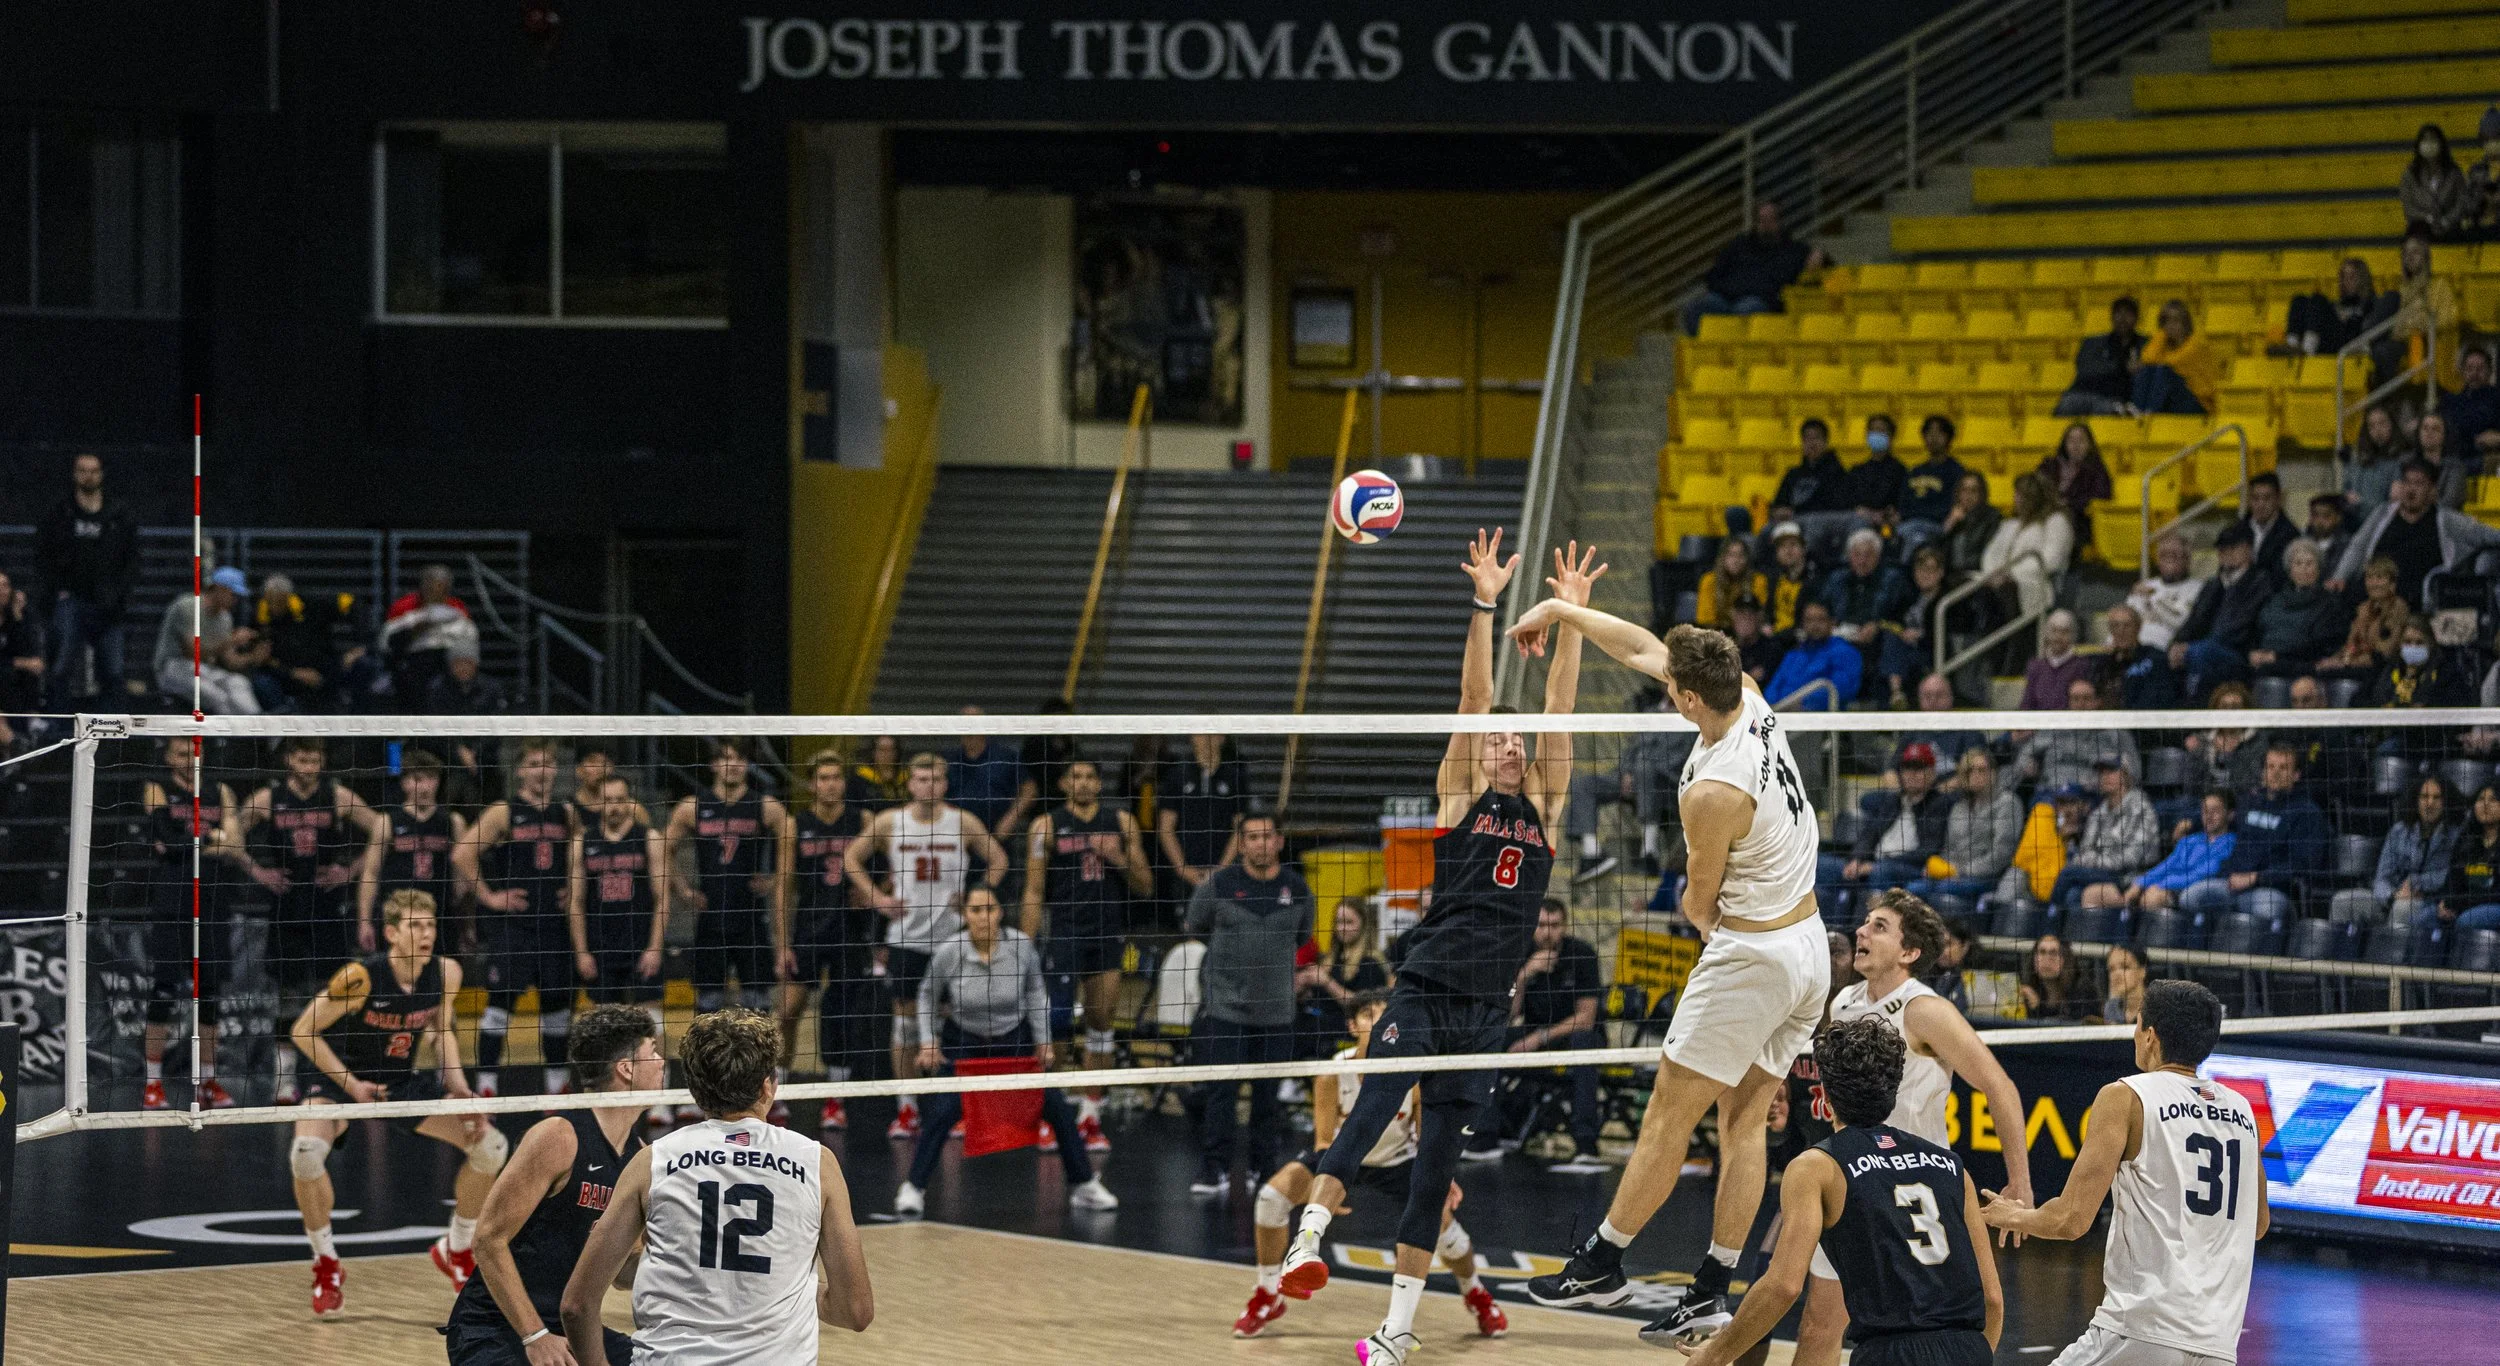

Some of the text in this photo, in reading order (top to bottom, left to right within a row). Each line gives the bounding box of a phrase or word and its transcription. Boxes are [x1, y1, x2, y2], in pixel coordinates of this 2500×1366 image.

[740, 17, 1796, 93] JOSEPH THOMAS GANNON
[1493, 845, 1525, 889] 8
[0, 946, 67, 996] ES
[385, 1032, 413, 1058] 2
[1945, 1088, 2093, 1159] BEA
[2160, 1102, 2255, 1138] LONG BEACH
[666, 1150, 806, 1185] LONG BEACH
[1848, 1151, 1958, 1179] LONG BEACH
[2185, 1132, 2241, 1221] 31
[2371, 1174, 2457, 1203] Instant
[697, 1180, 775, 1274] 12
[1893, 1182, 1951, 1266] 3
